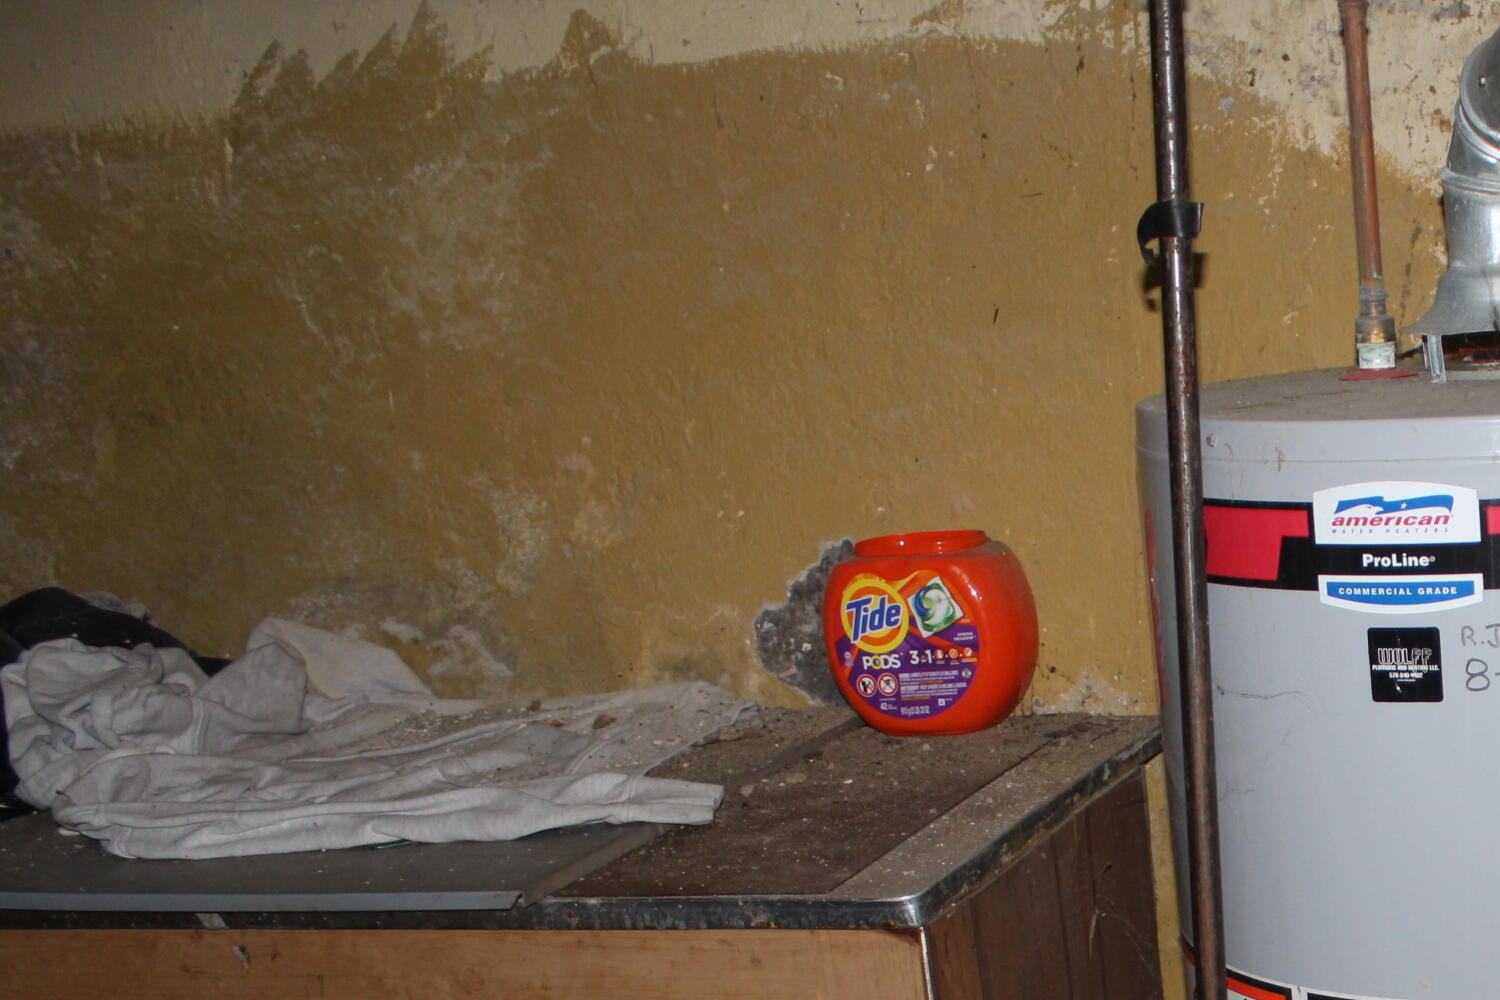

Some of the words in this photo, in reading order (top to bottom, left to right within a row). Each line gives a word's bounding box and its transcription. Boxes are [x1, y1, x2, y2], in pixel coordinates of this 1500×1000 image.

[1331, 514, 1450, 527] american
[1338, 587, 1413, 595] COMMERCIAL
[1417, 587, 1457, 595] GRADE
[845, 594, 902, 644] Tide
[861, 653, 901, 671] PODS
[1377, 647, 1433, 666] WOLFF
